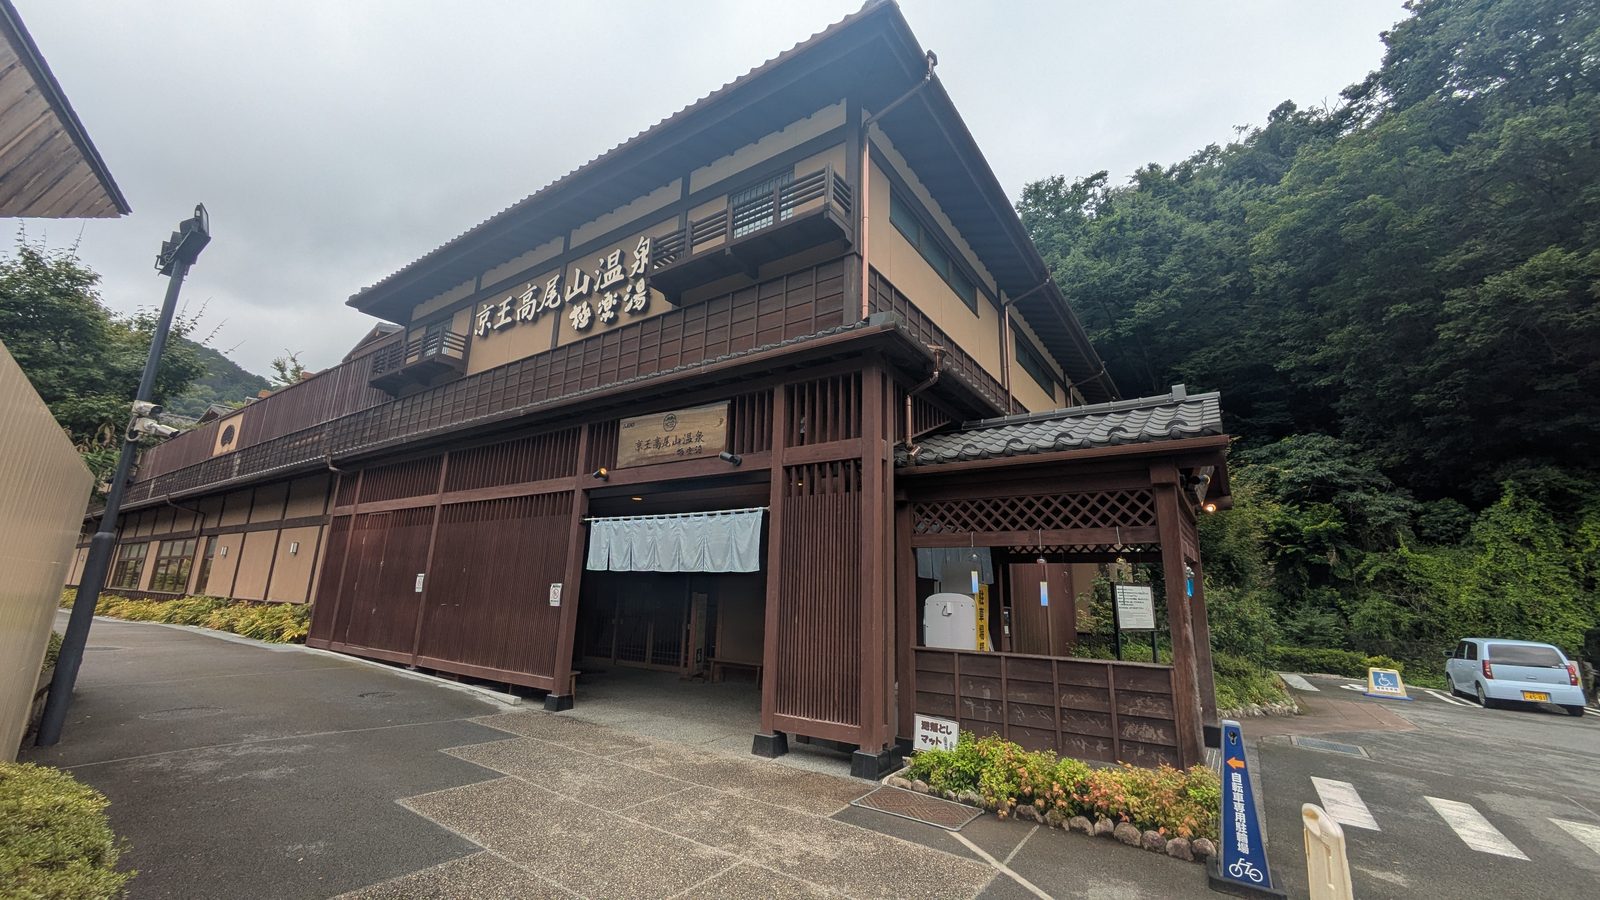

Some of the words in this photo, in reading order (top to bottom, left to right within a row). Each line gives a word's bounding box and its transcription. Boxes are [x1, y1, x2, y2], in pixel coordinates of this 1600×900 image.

[474, 236, 650, 336] 京王高尾山温泉
[569, 279, 647, 330] 極楽湯
[635, 430, 704, 452] 京王高尾山温泉
[921, 735, 942, 746] マット
